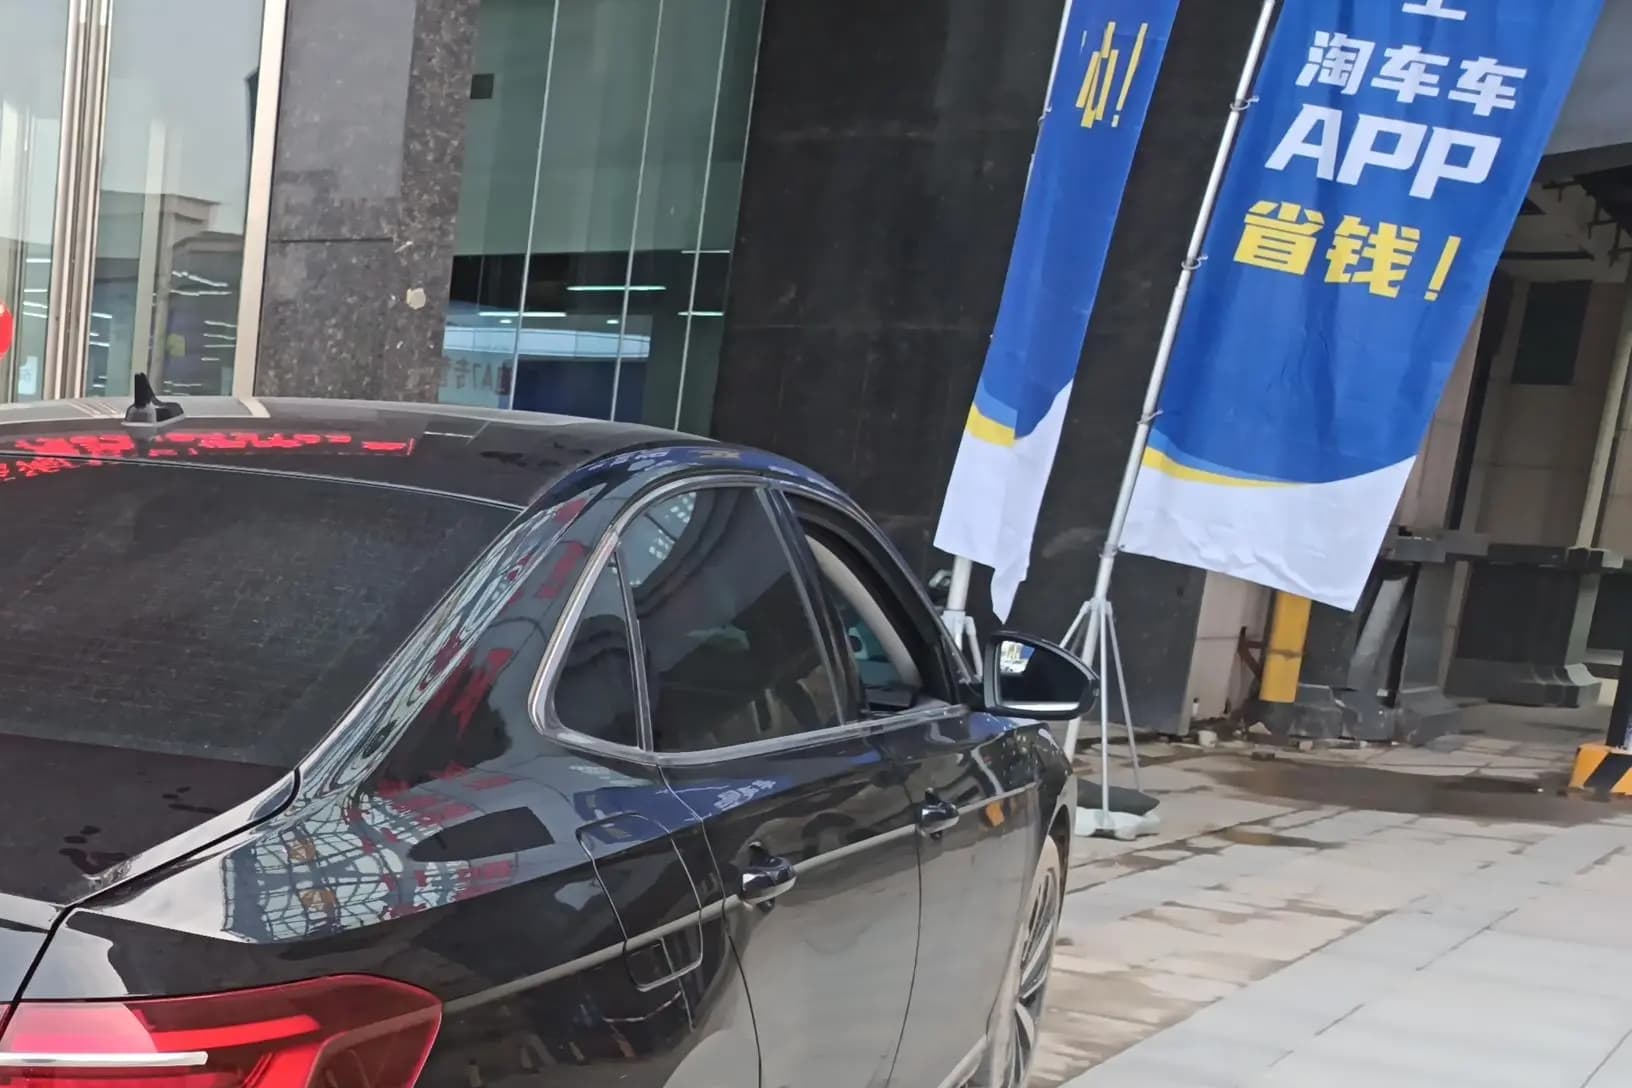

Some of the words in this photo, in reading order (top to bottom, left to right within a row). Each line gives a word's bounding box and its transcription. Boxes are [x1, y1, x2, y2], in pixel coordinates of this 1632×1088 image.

[1295, 30, 1528, 117] 淘车车
[1264, 103, 1502, 200] APP
[1233, 200, 1462, 302] 省钱！
